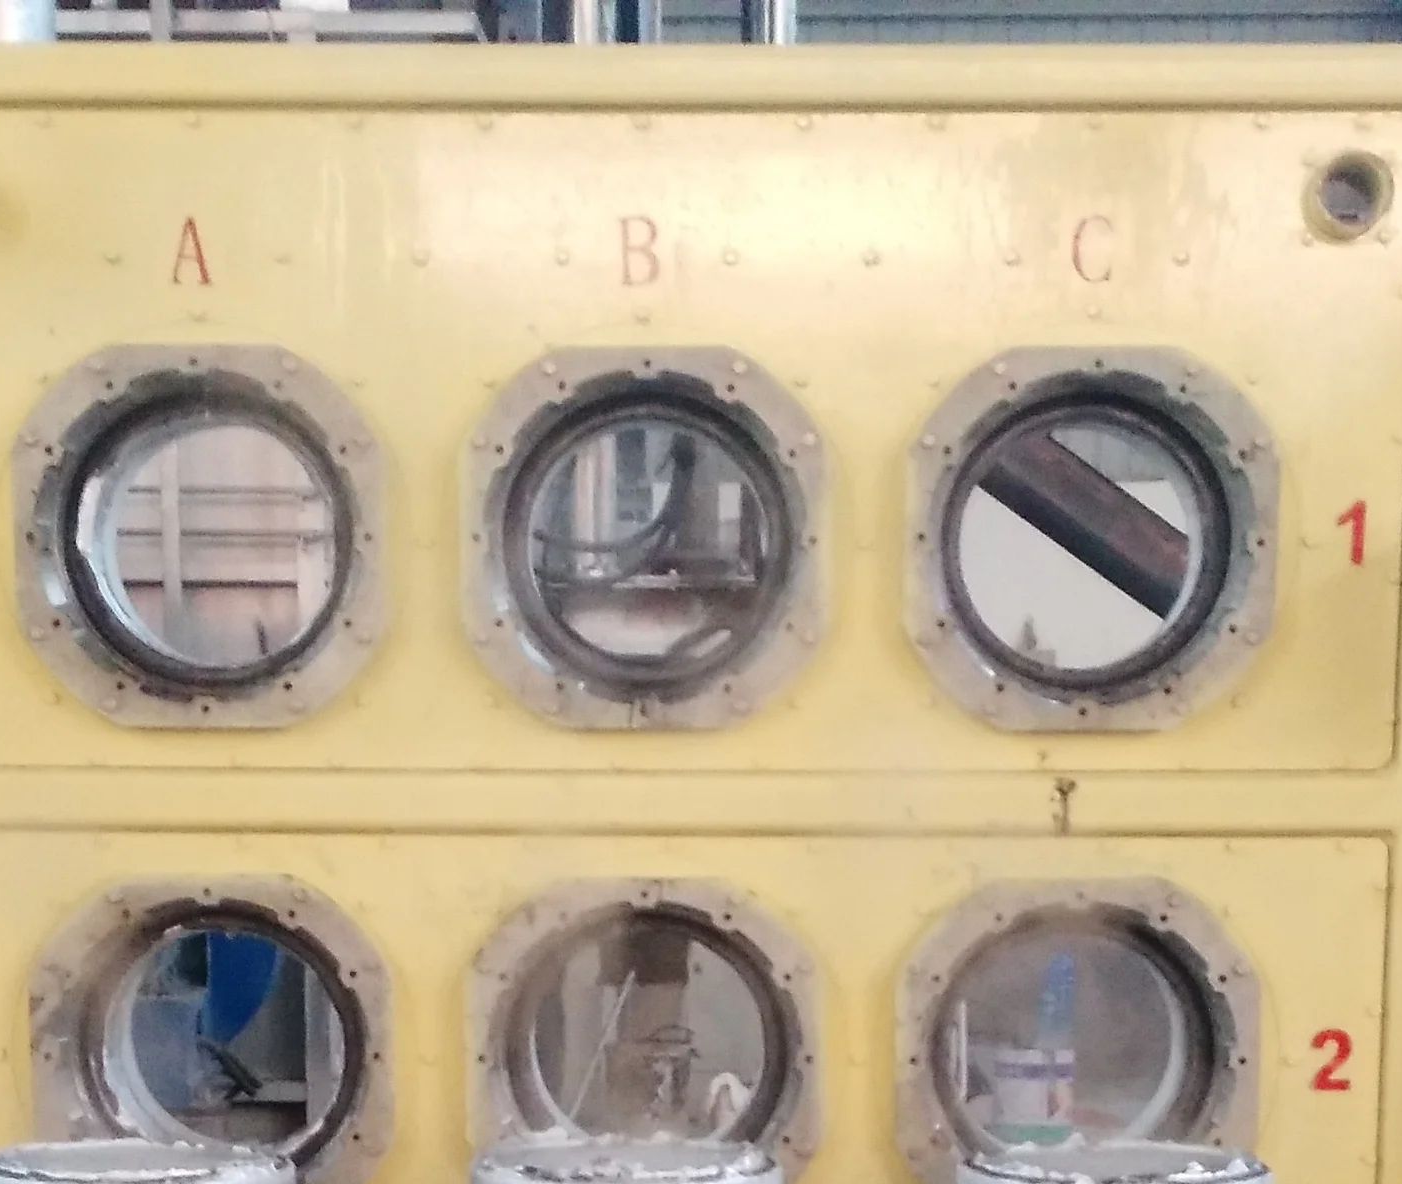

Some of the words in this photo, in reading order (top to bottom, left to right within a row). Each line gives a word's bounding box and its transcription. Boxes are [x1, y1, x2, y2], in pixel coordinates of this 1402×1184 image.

[171, 215, 212, 287] A
[617, 213, 661, 287] B
[1071, 213, 1114, 284] C
[1336, 500, 1367, 566] 1
[1309, 1028, 1352, 1092] 2
